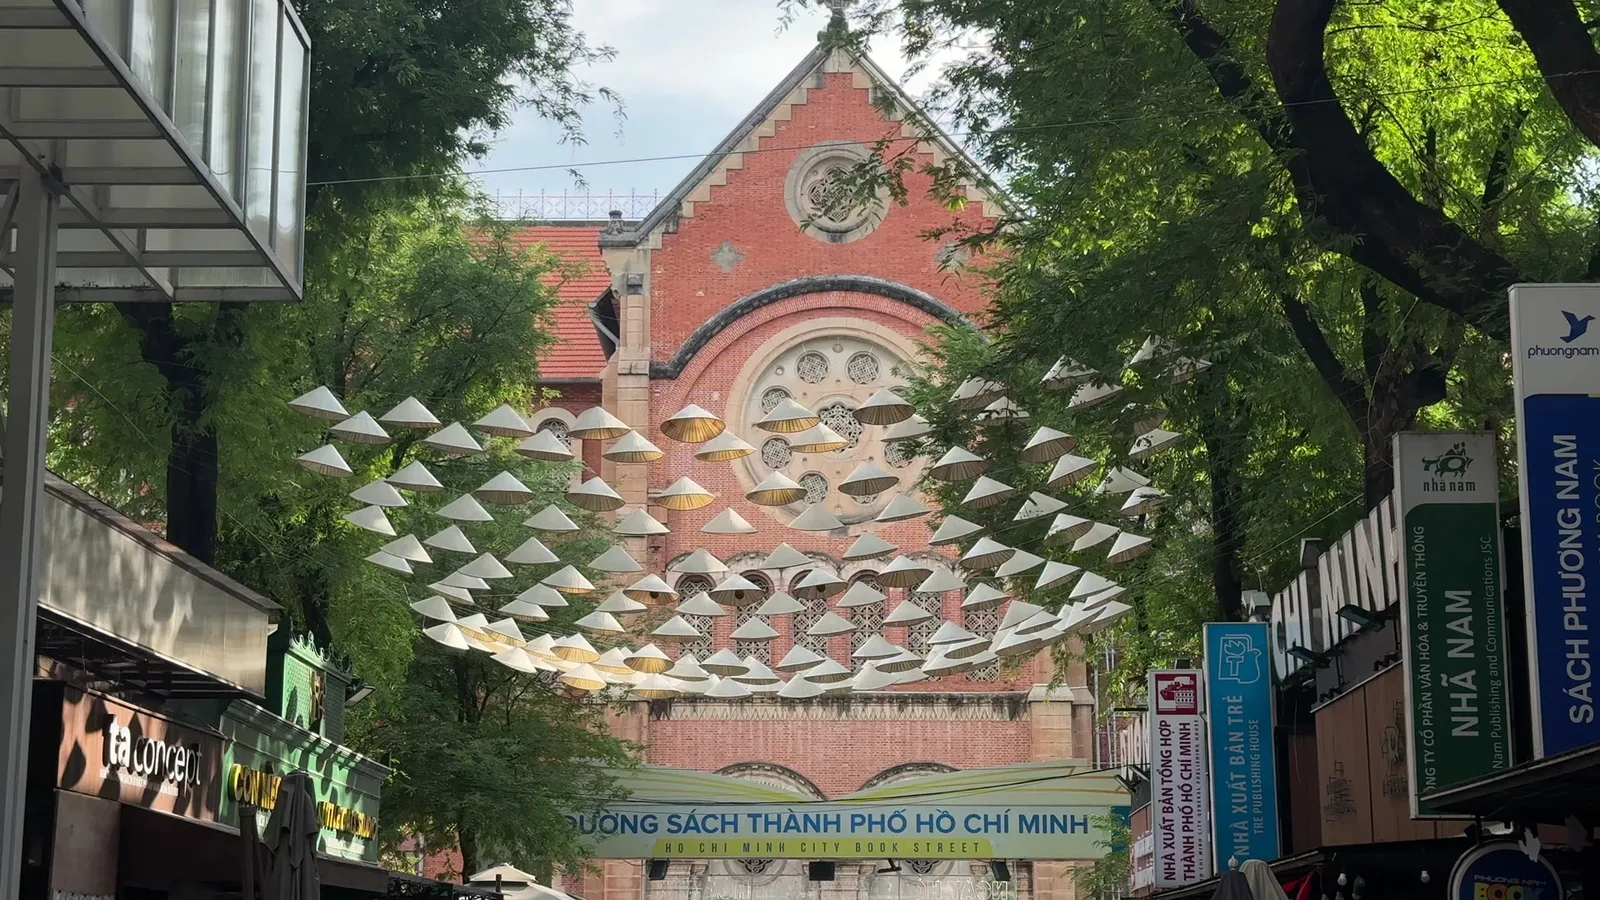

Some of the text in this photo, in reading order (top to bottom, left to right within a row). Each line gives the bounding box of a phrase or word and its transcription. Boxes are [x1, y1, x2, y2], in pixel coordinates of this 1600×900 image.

[1411, 525, 1427, 569] THÔNG
[1412, 571, 1429, 618] TRUYỀN
[1552, 434, 1595, 724] SÁCH PHƯƠNG NAM
[1416, 633, 1431, 661] HÓA
[1418, 621, 1429, 631] &
[1440, 589, 1480, 738] NHÃ NAM
[1480, 532, 1504, 768] Nam Publishing and Communications JSC.
[1416, 663, 1433, 689] VĂN
[1416, 693, 1434, 727] PHẦN
[109, 714, 131, 768] ta
[133, 734, 203, 797] concept
[1248, 719, 1260, 751] HOUSE
[1418, 728, 1435, 747] CỔ
[1423, 749, 1436, 765] TY
[1221, 695, 1250, 856] NHÀ XUẤT BẢN TRẺ
[1250, 754, 1263, 814] PUBLISHING
[666, 808, 739, 834] SÁCH
[747, 808, 841, 834] THÀNH
[850, 808, 907, 834] PHỐ
[916, 808, 956, 834] HỒ
[963, 808, 1010, 834] CHÍ
[1018, 814, 1088, 834] MINH
[1156, 719, 1176, 881] NHÀ XUẤT BẢN TỔNG HỢP
[1177, 722, 1195, 881] THÀNH PHỐ HỒ CHÍ MINH
[665, 842, 980, 853] HO CHI MINH CITY BOOK STREET
